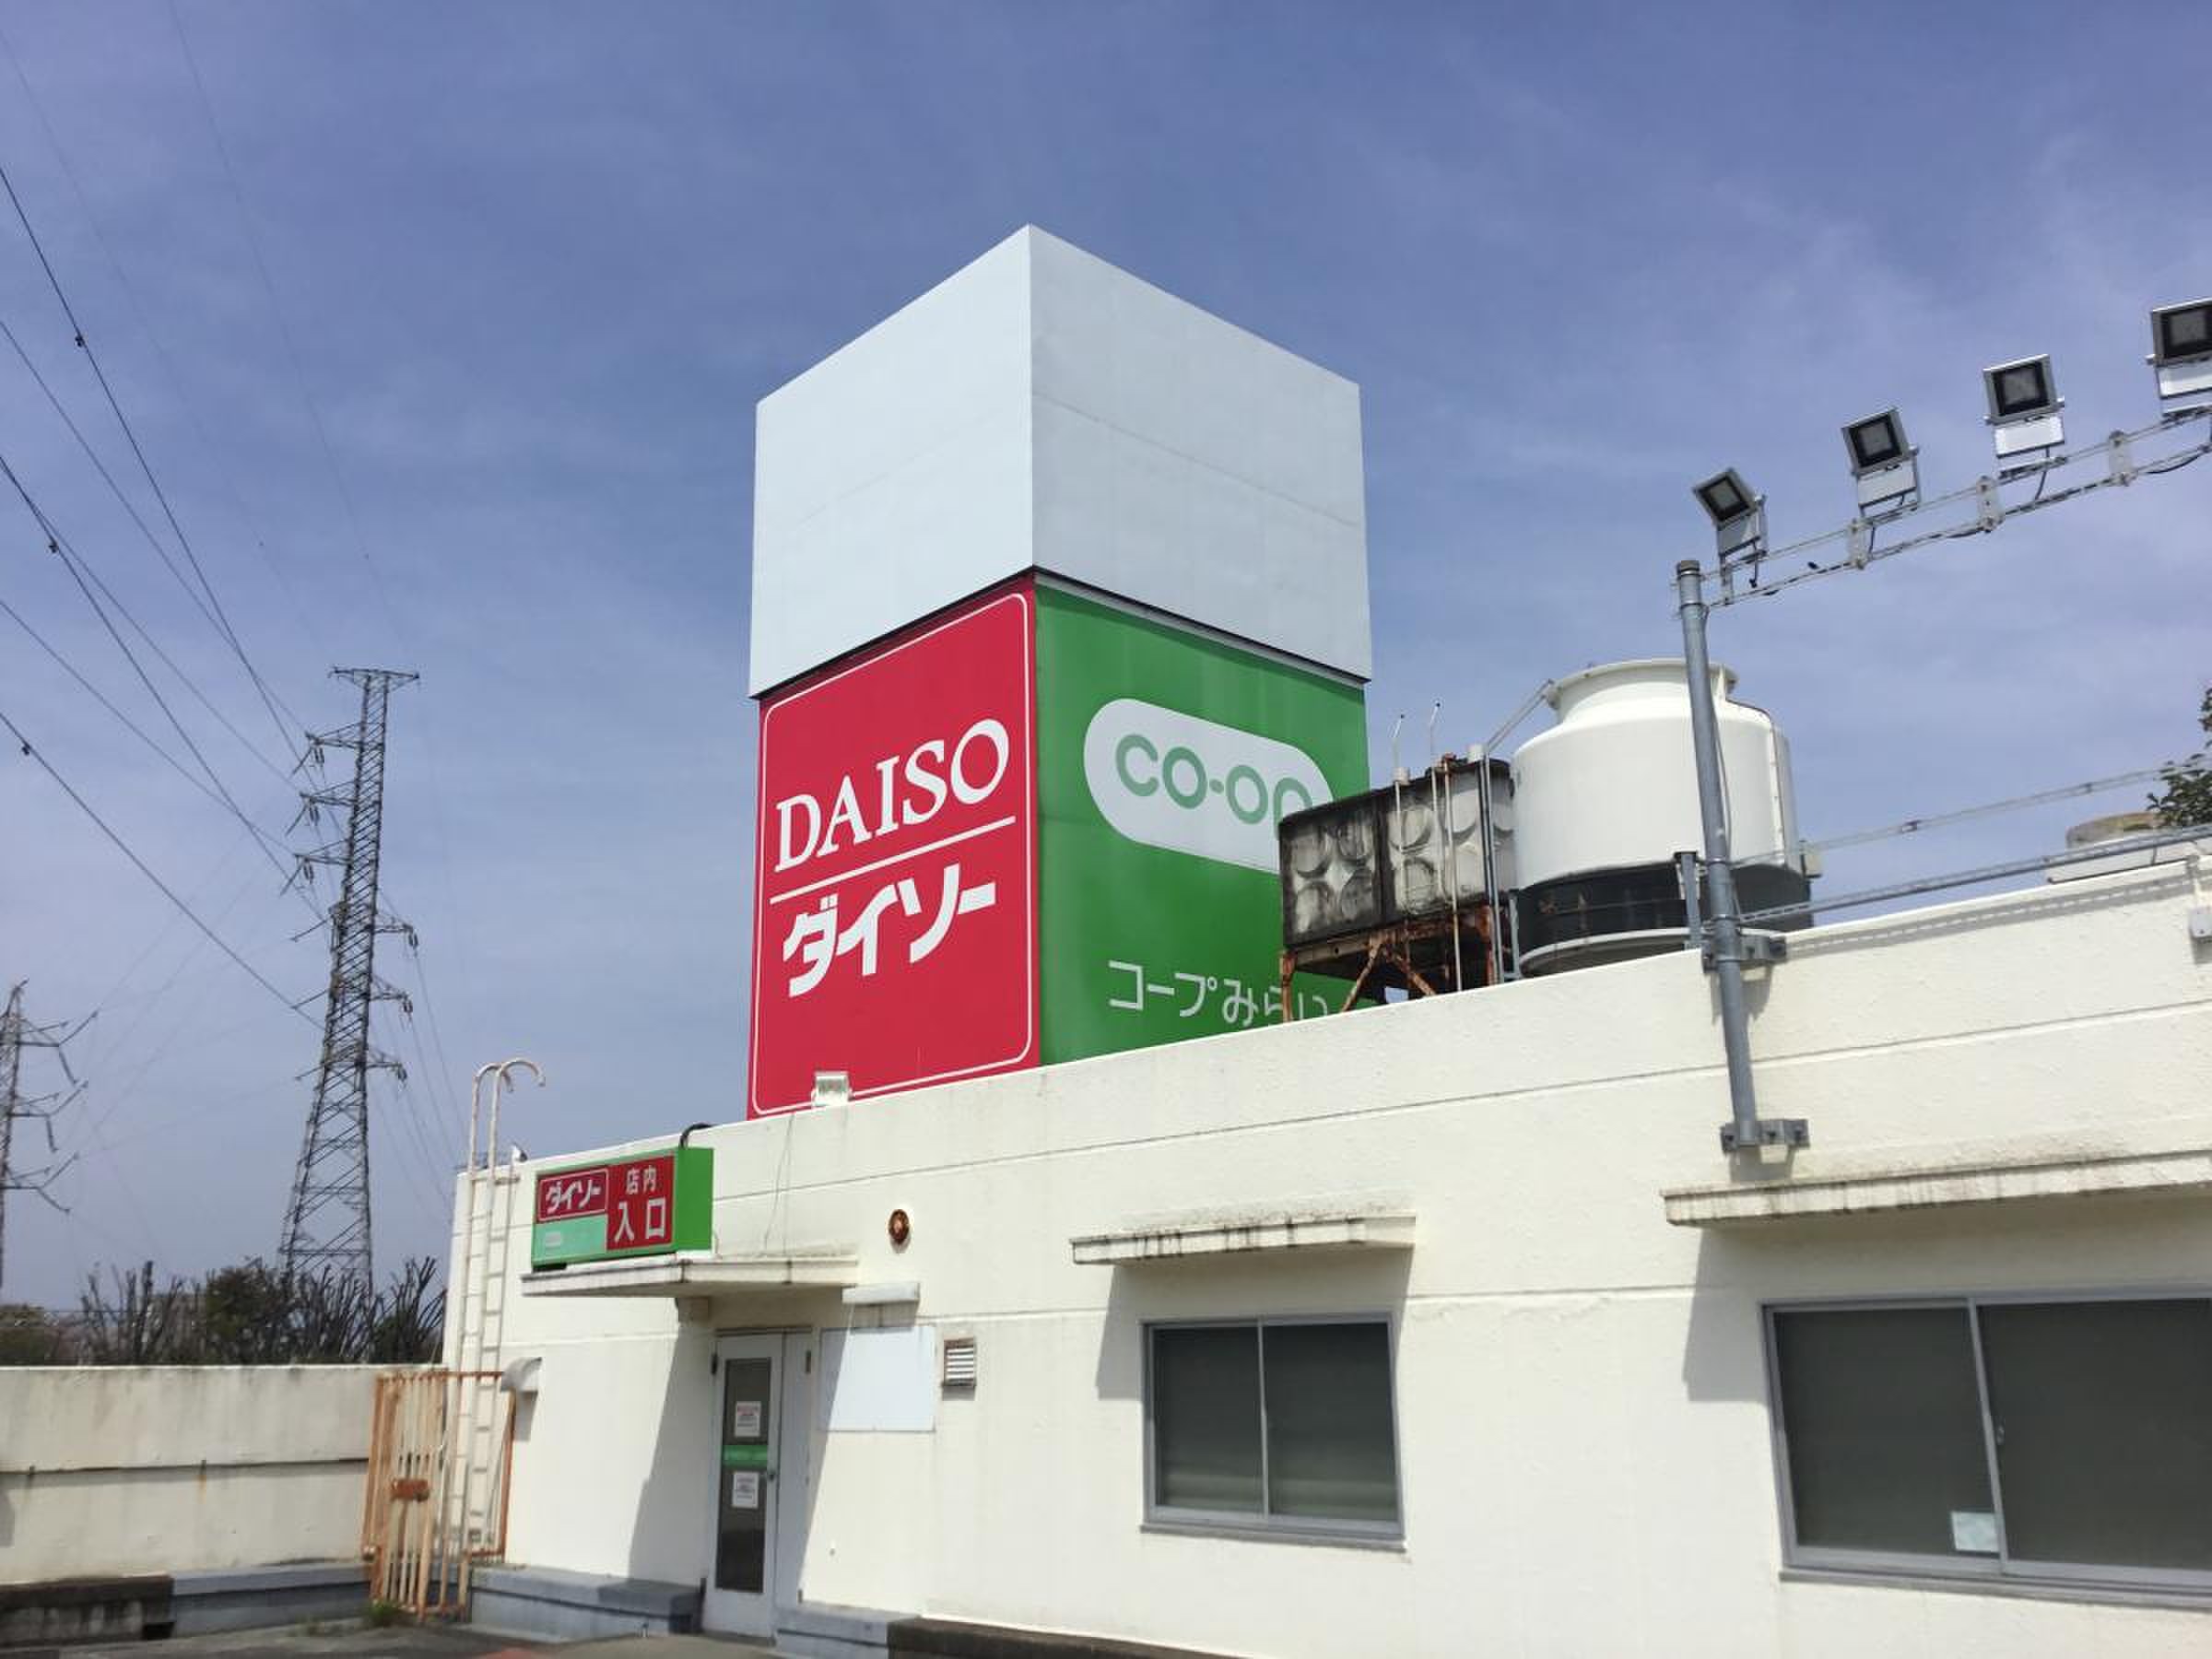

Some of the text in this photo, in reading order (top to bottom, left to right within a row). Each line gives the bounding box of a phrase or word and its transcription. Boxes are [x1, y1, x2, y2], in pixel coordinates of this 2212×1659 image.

[773, 718, 1009, 872] DAISO
[782, 863, 996, 998] ダイソー
[546, 1179, 601, 1214] ダイソー
[627, 1166, 657, 1194] 店内
[615, 1198, 665, 1241] 入口
